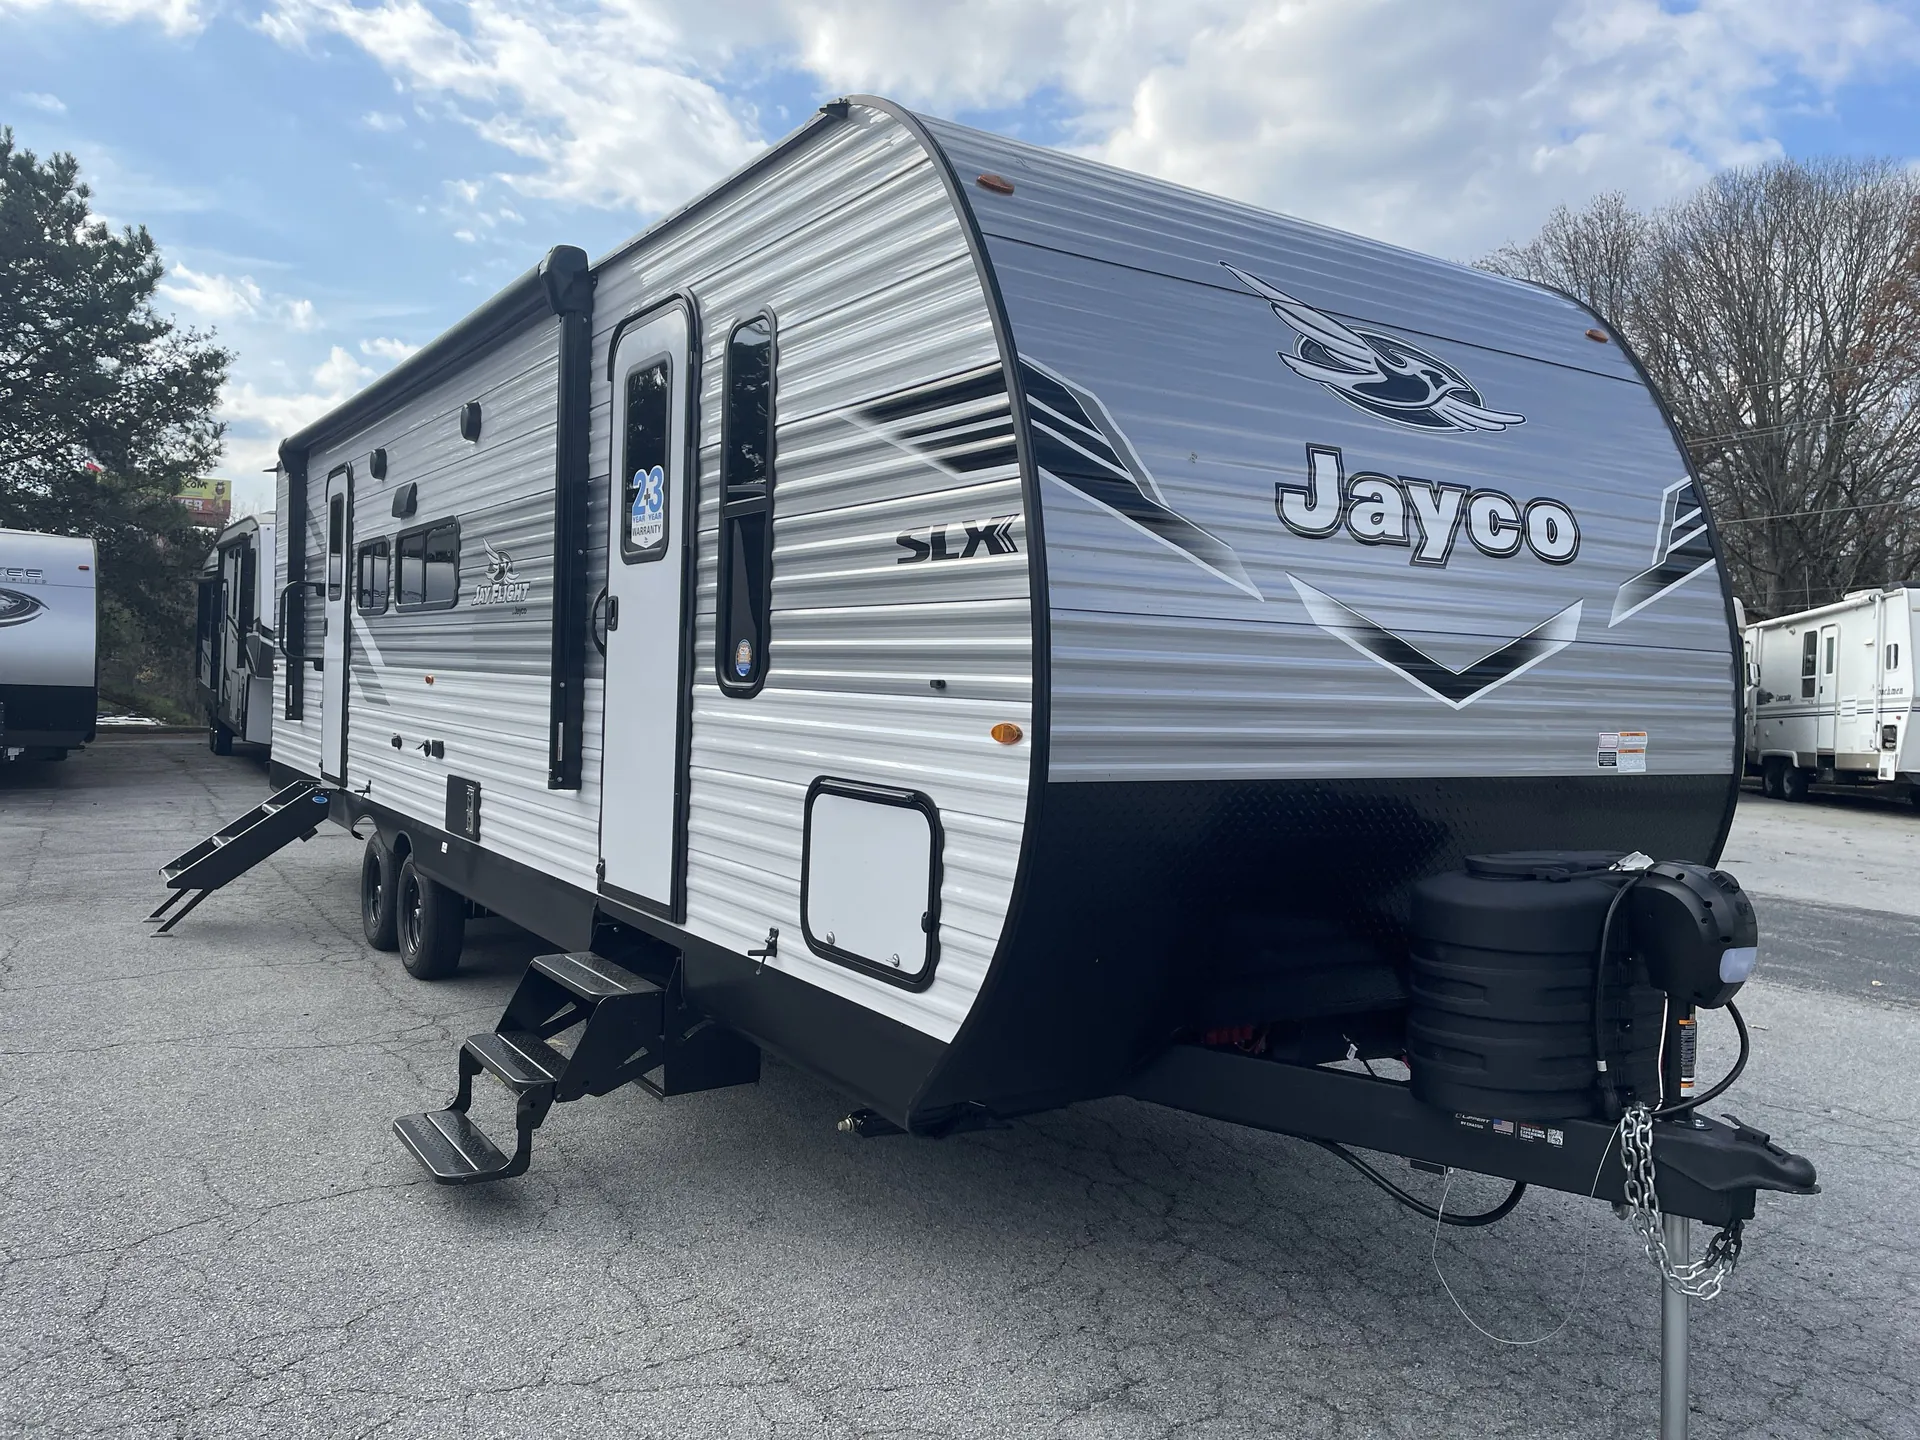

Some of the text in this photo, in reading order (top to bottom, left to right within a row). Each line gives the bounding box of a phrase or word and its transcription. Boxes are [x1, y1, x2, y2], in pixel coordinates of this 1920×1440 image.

[633, 512, 662, 523] YEAR YEAR
[1275, 442, 1581, 569] Jayco
[632, 524, 662, 537] WARRANTY
[896, 513, 1020, 564] SLX
[471, 581, 531, 606] JAY FLIGHT
